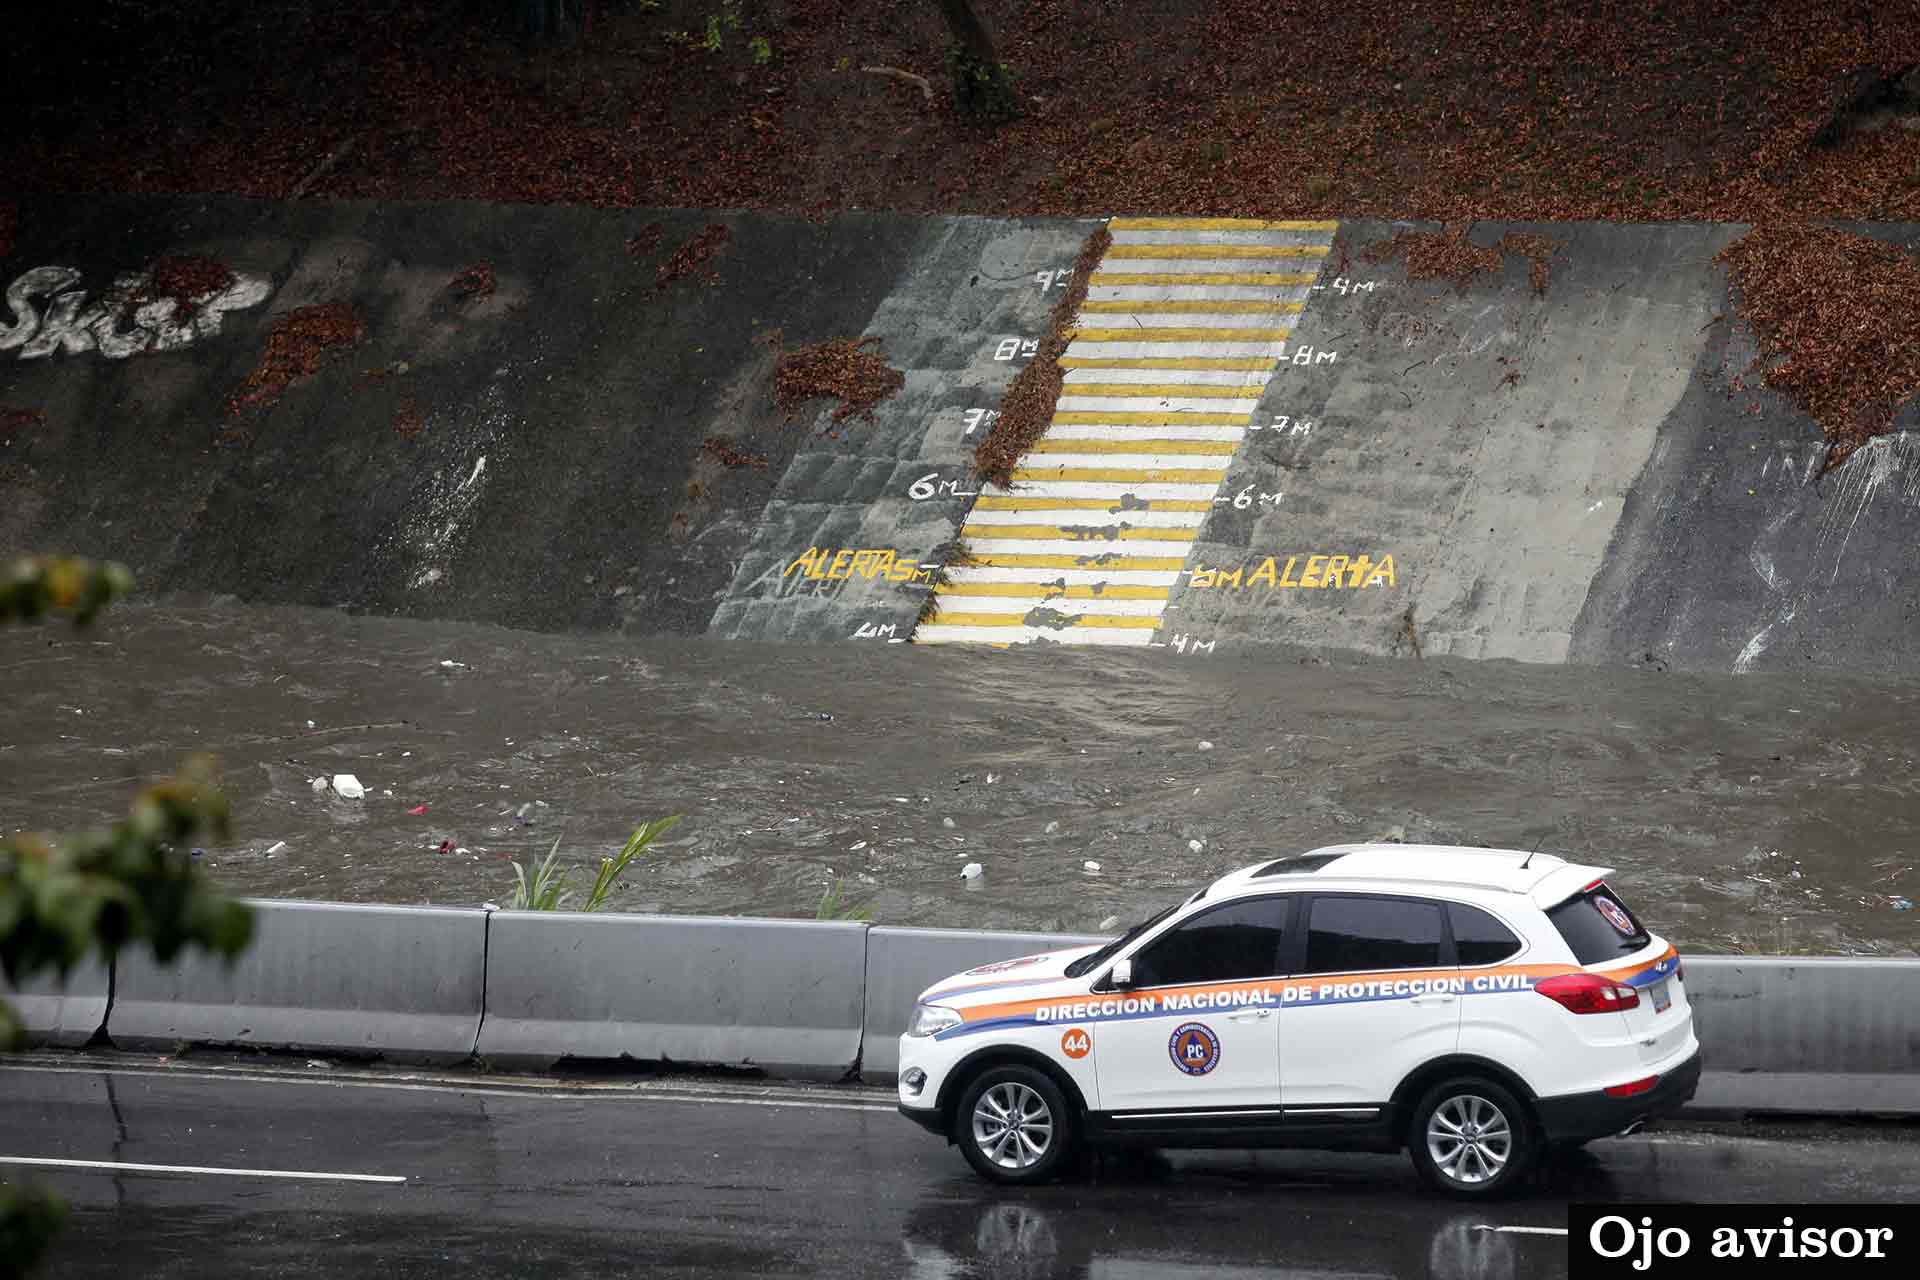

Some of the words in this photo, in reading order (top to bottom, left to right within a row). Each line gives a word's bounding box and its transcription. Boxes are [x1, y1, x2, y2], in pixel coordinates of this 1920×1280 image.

[994, 338, 1039, 360] 8M
[1292, 344, 1337, 365] 8M
[908, 472, 957, 500] 6M
[1233, 484, 1283, 509] 6M
[1035, 998, 1155, 1021] DIRECCION
[1162, 989, 1276, 1011] NACIONAL
[1282, 986, 1312, 1003] DE
[1319, 977, 1465, 1000] PROTECCION
[1473, 974, 1535, 991] CIVIL
[1064, 1034, 1090, 1052] 44
[1186, 1044, 1204, 1059] PC
